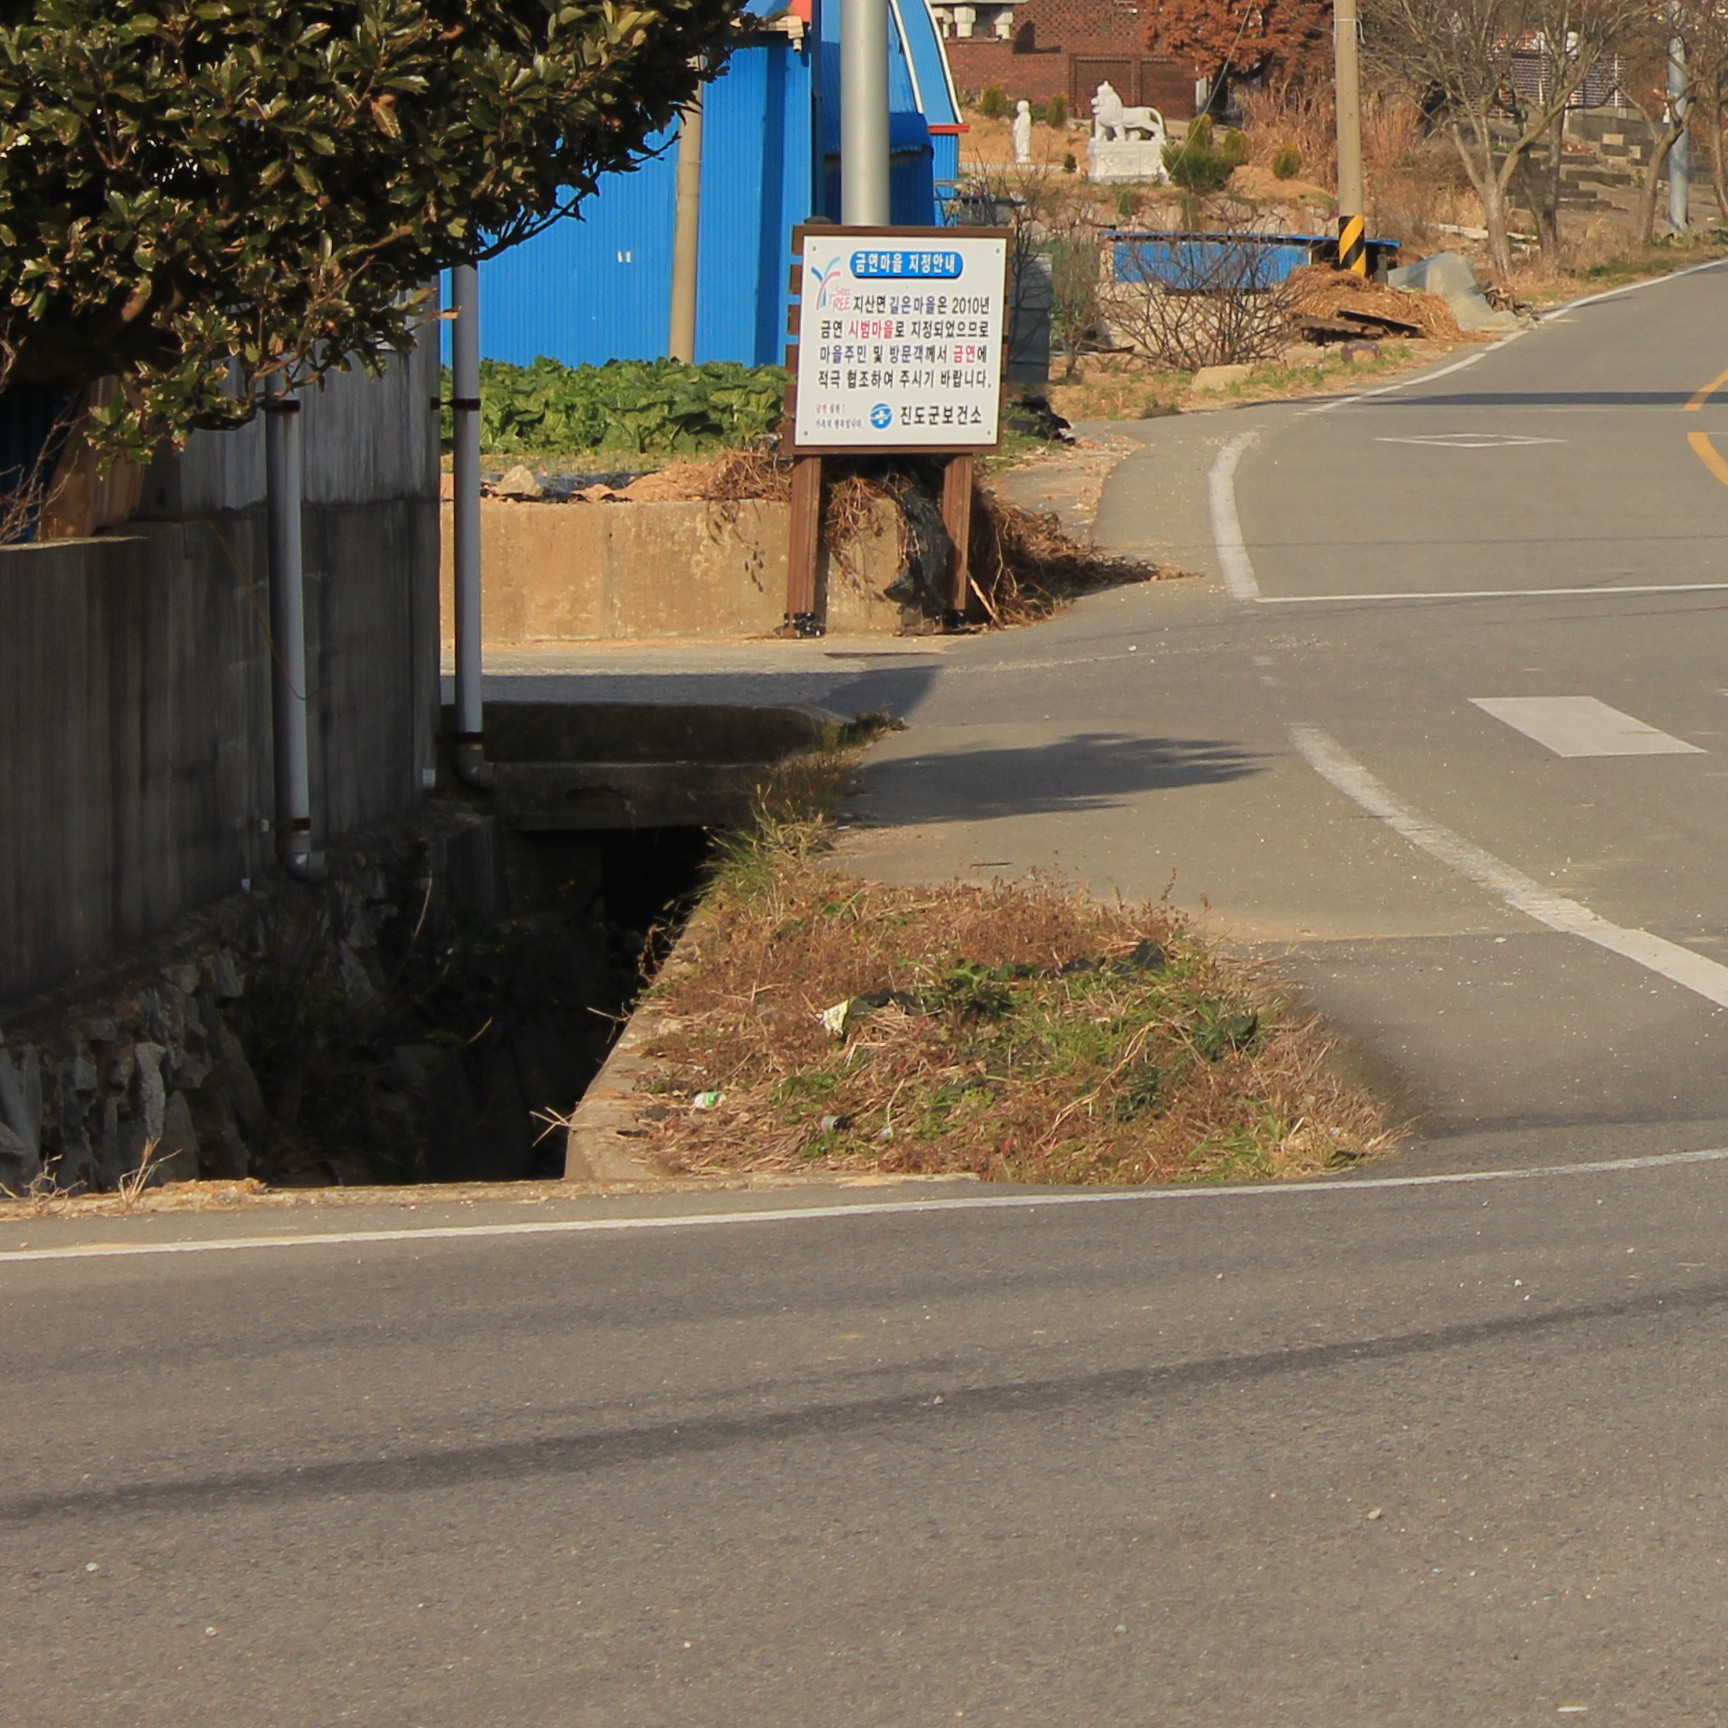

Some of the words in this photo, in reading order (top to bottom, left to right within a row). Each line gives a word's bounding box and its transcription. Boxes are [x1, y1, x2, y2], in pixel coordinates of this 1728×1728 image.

[855, 253, 903, 273] 금연마을
[908, 253, 956, 274] 지정안내
[853, 295, 886, 315] 지산면
[951, 296, 990, 315] 2010년
[820, 320, 843, 339] 금연
[849, 320, 905, 339] 시범마을로
[910, 320, 989, 339] 지정되었으므로
[819, 344, 867, 364] 마을주민
[873, 345, 883, 364] 및
[889, 344, 948, 364] 방문객께서
[953, 344, 987, 364] 금연에
[818, 369, 841, 389] 적극
[847, 369, 894, 389] 협조하여
[898, 369, 935, 389] 주시기
[940, 369, 992, 389] 바랍니다.
[900, 404, 983, 426] 진도군보건소
